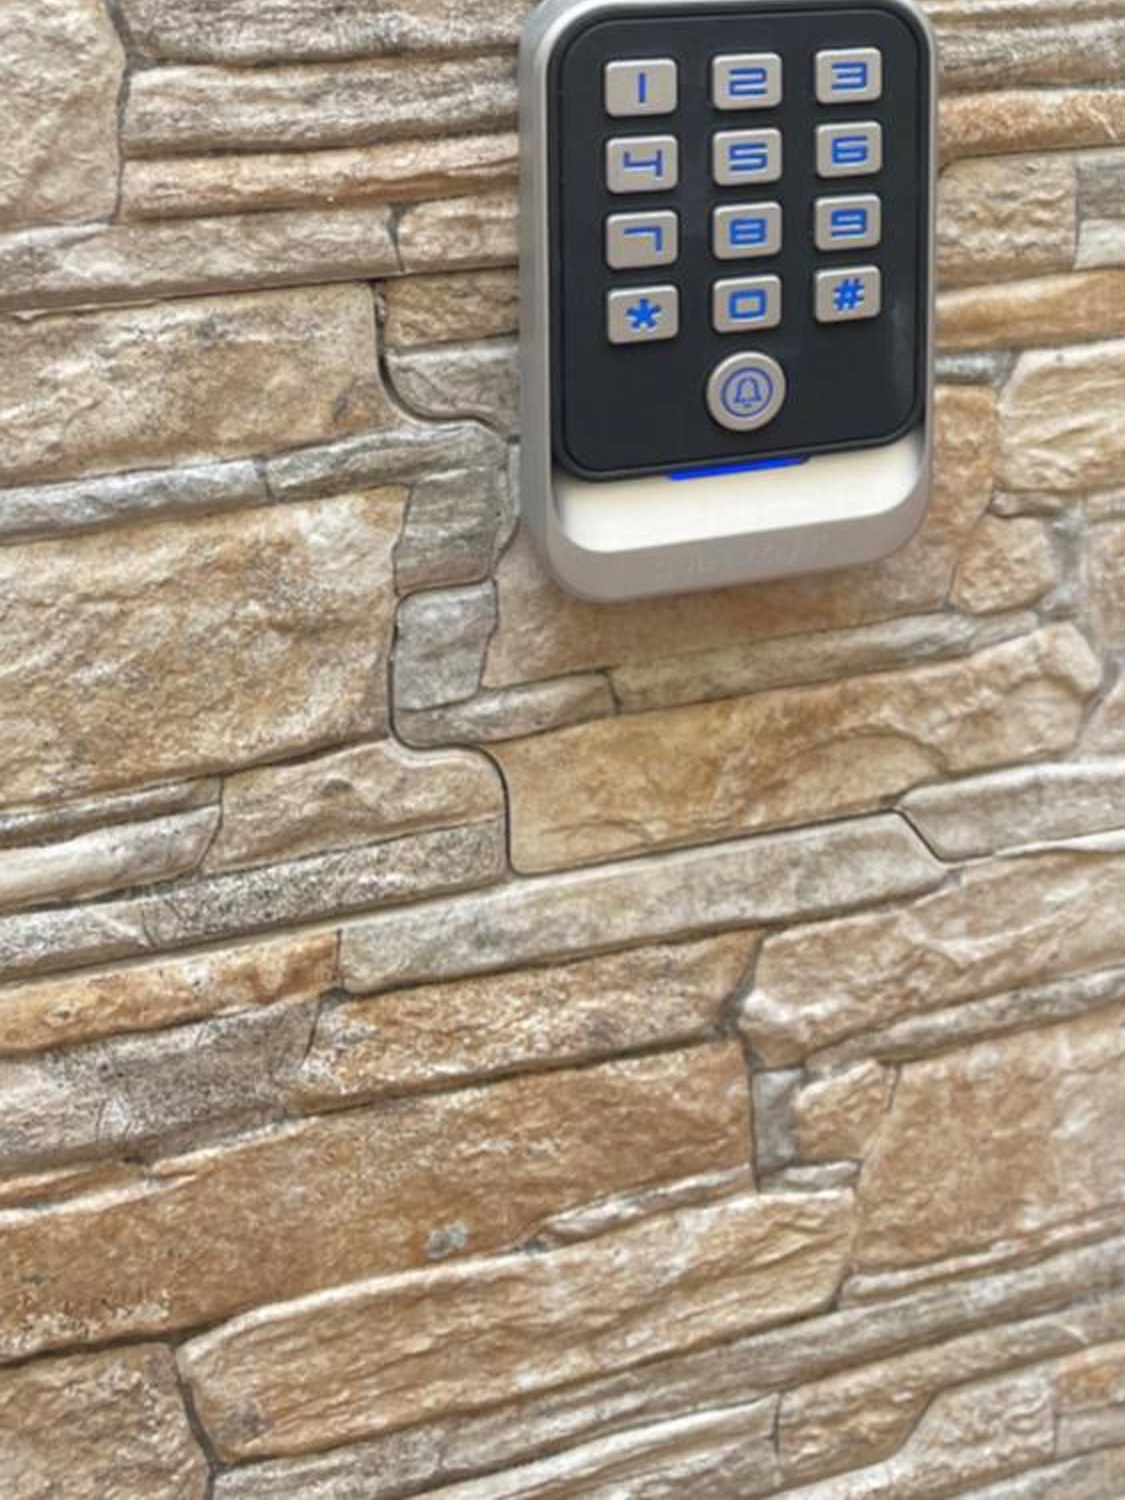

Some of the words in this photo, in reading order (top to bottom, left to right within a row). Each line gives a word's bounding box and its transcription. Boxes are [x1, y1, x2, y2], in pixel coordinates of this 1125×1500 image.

[637, 71, 648, 103] 1
[728, 67, 768, 98] 2
[831, 61, 868, 91] 3
[622, 149, 664, 178] 4
[728, 142, 768, 173] 5
[831, 135, 868, 165] 6
[622, 225, 664, 252] 7
[728, 216, 768, 247] 8
[831, 208, 868, 238] 9
[728, 289, 768, 321] 0
[833, 277, 865, 312] #
